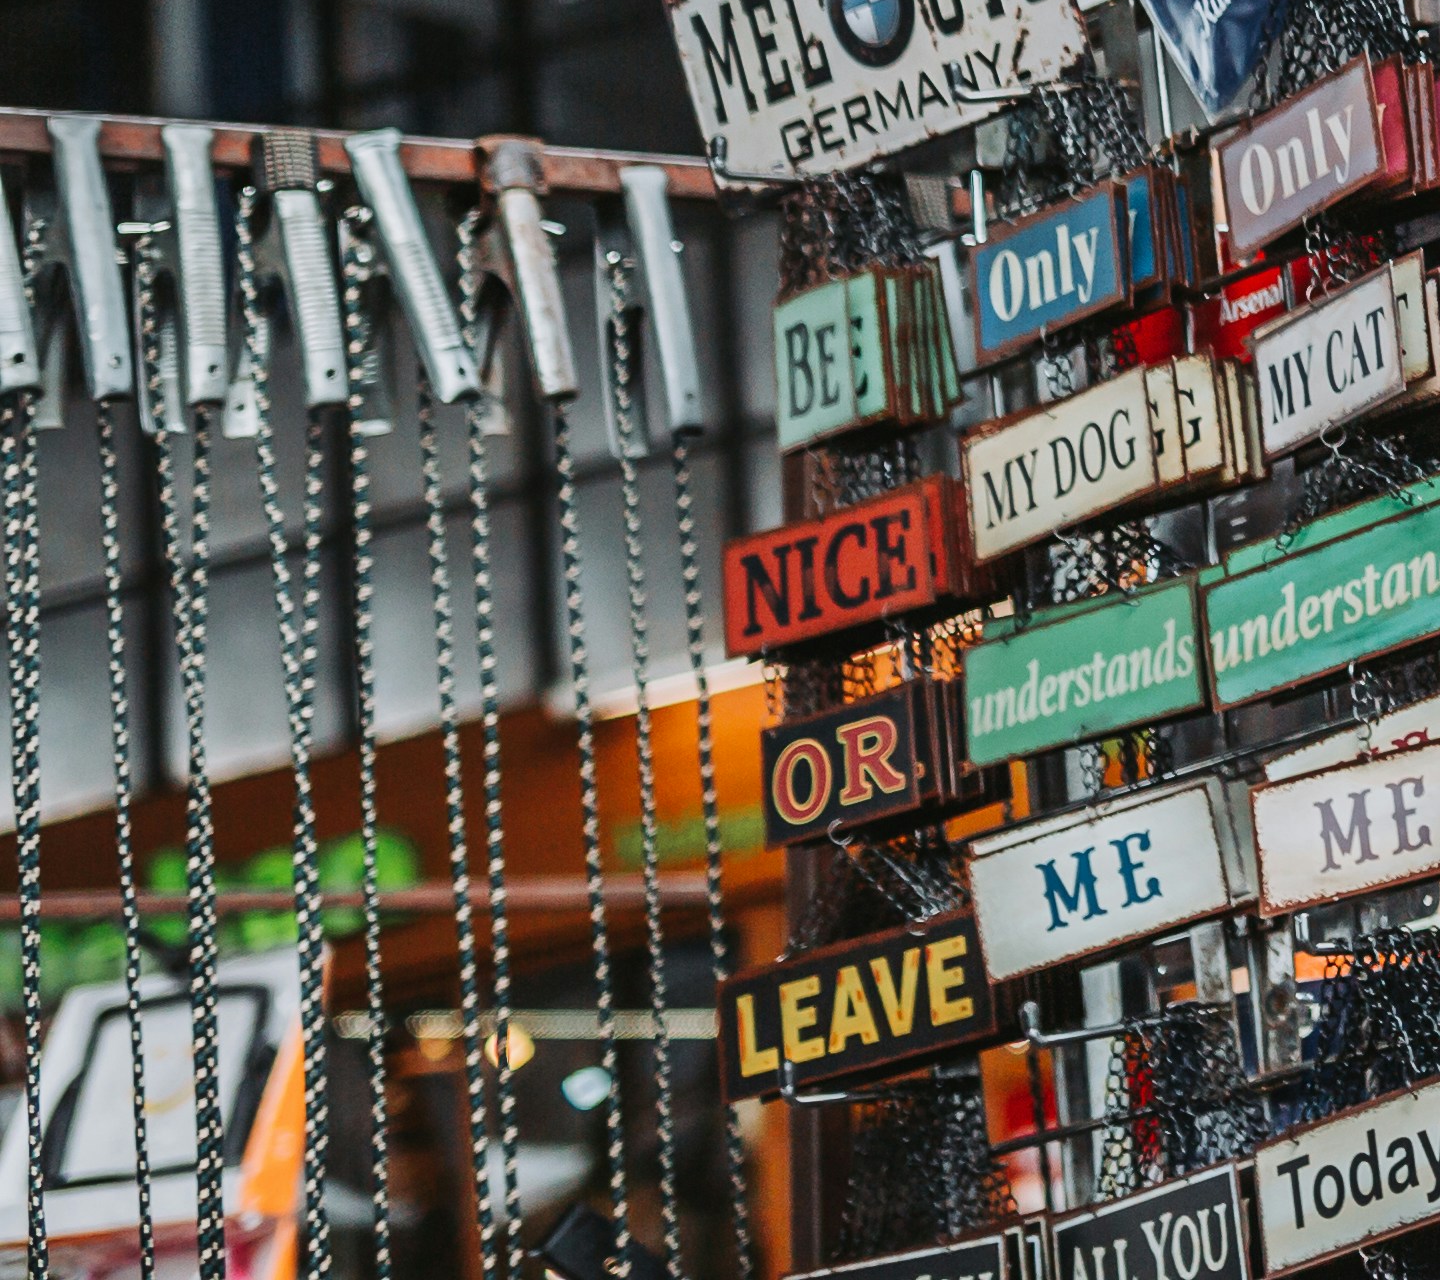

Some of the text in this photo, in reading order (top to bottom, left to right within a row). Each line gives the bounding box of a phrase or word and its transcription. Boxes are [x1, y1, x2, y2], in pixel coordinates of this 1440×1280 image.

[778, 41, 1003, 165] GERMANY
[1238, 100, 1358, 218] Only
[988, 220, 1102, 324] Only
[1219, 274, 1285, 326] Arsenal
[1268, 304, 1390, 425] MY CAT
[980, 407, 1138, 531] MY DOG
[740, 507, 918, 639] NICE
[969, 617, 1197, 739] understands
[771, 715, 908, 827] OR
[1315, 775, 1432, 872] ME
[1034, 830, 1164, 934] ME
[735, 934, 976, 1078] LEAVE
[1139, 1201, 1229, 1279] YOU
